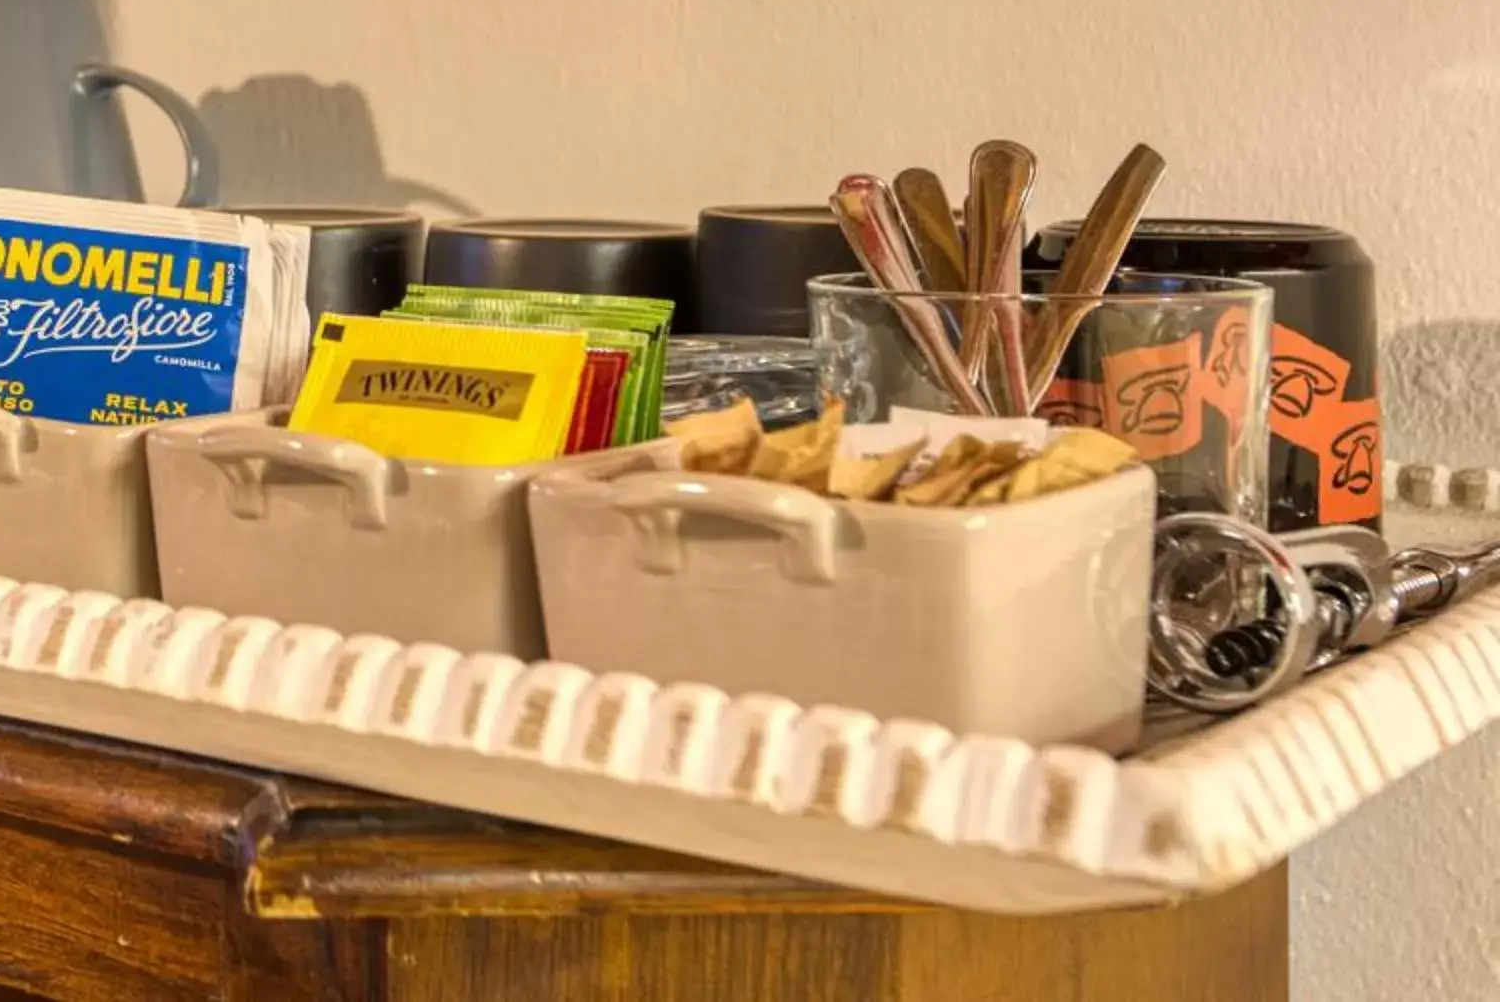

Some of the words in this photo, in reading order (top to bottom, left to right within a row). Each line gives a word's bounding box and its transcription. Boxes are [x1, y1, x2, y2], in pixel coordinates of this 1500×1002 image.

[154, 354, 222, 371] CAMOMILLA
[360, 370, 503, 410] TWININGS
[105, 393, 189, 417] RELAX
